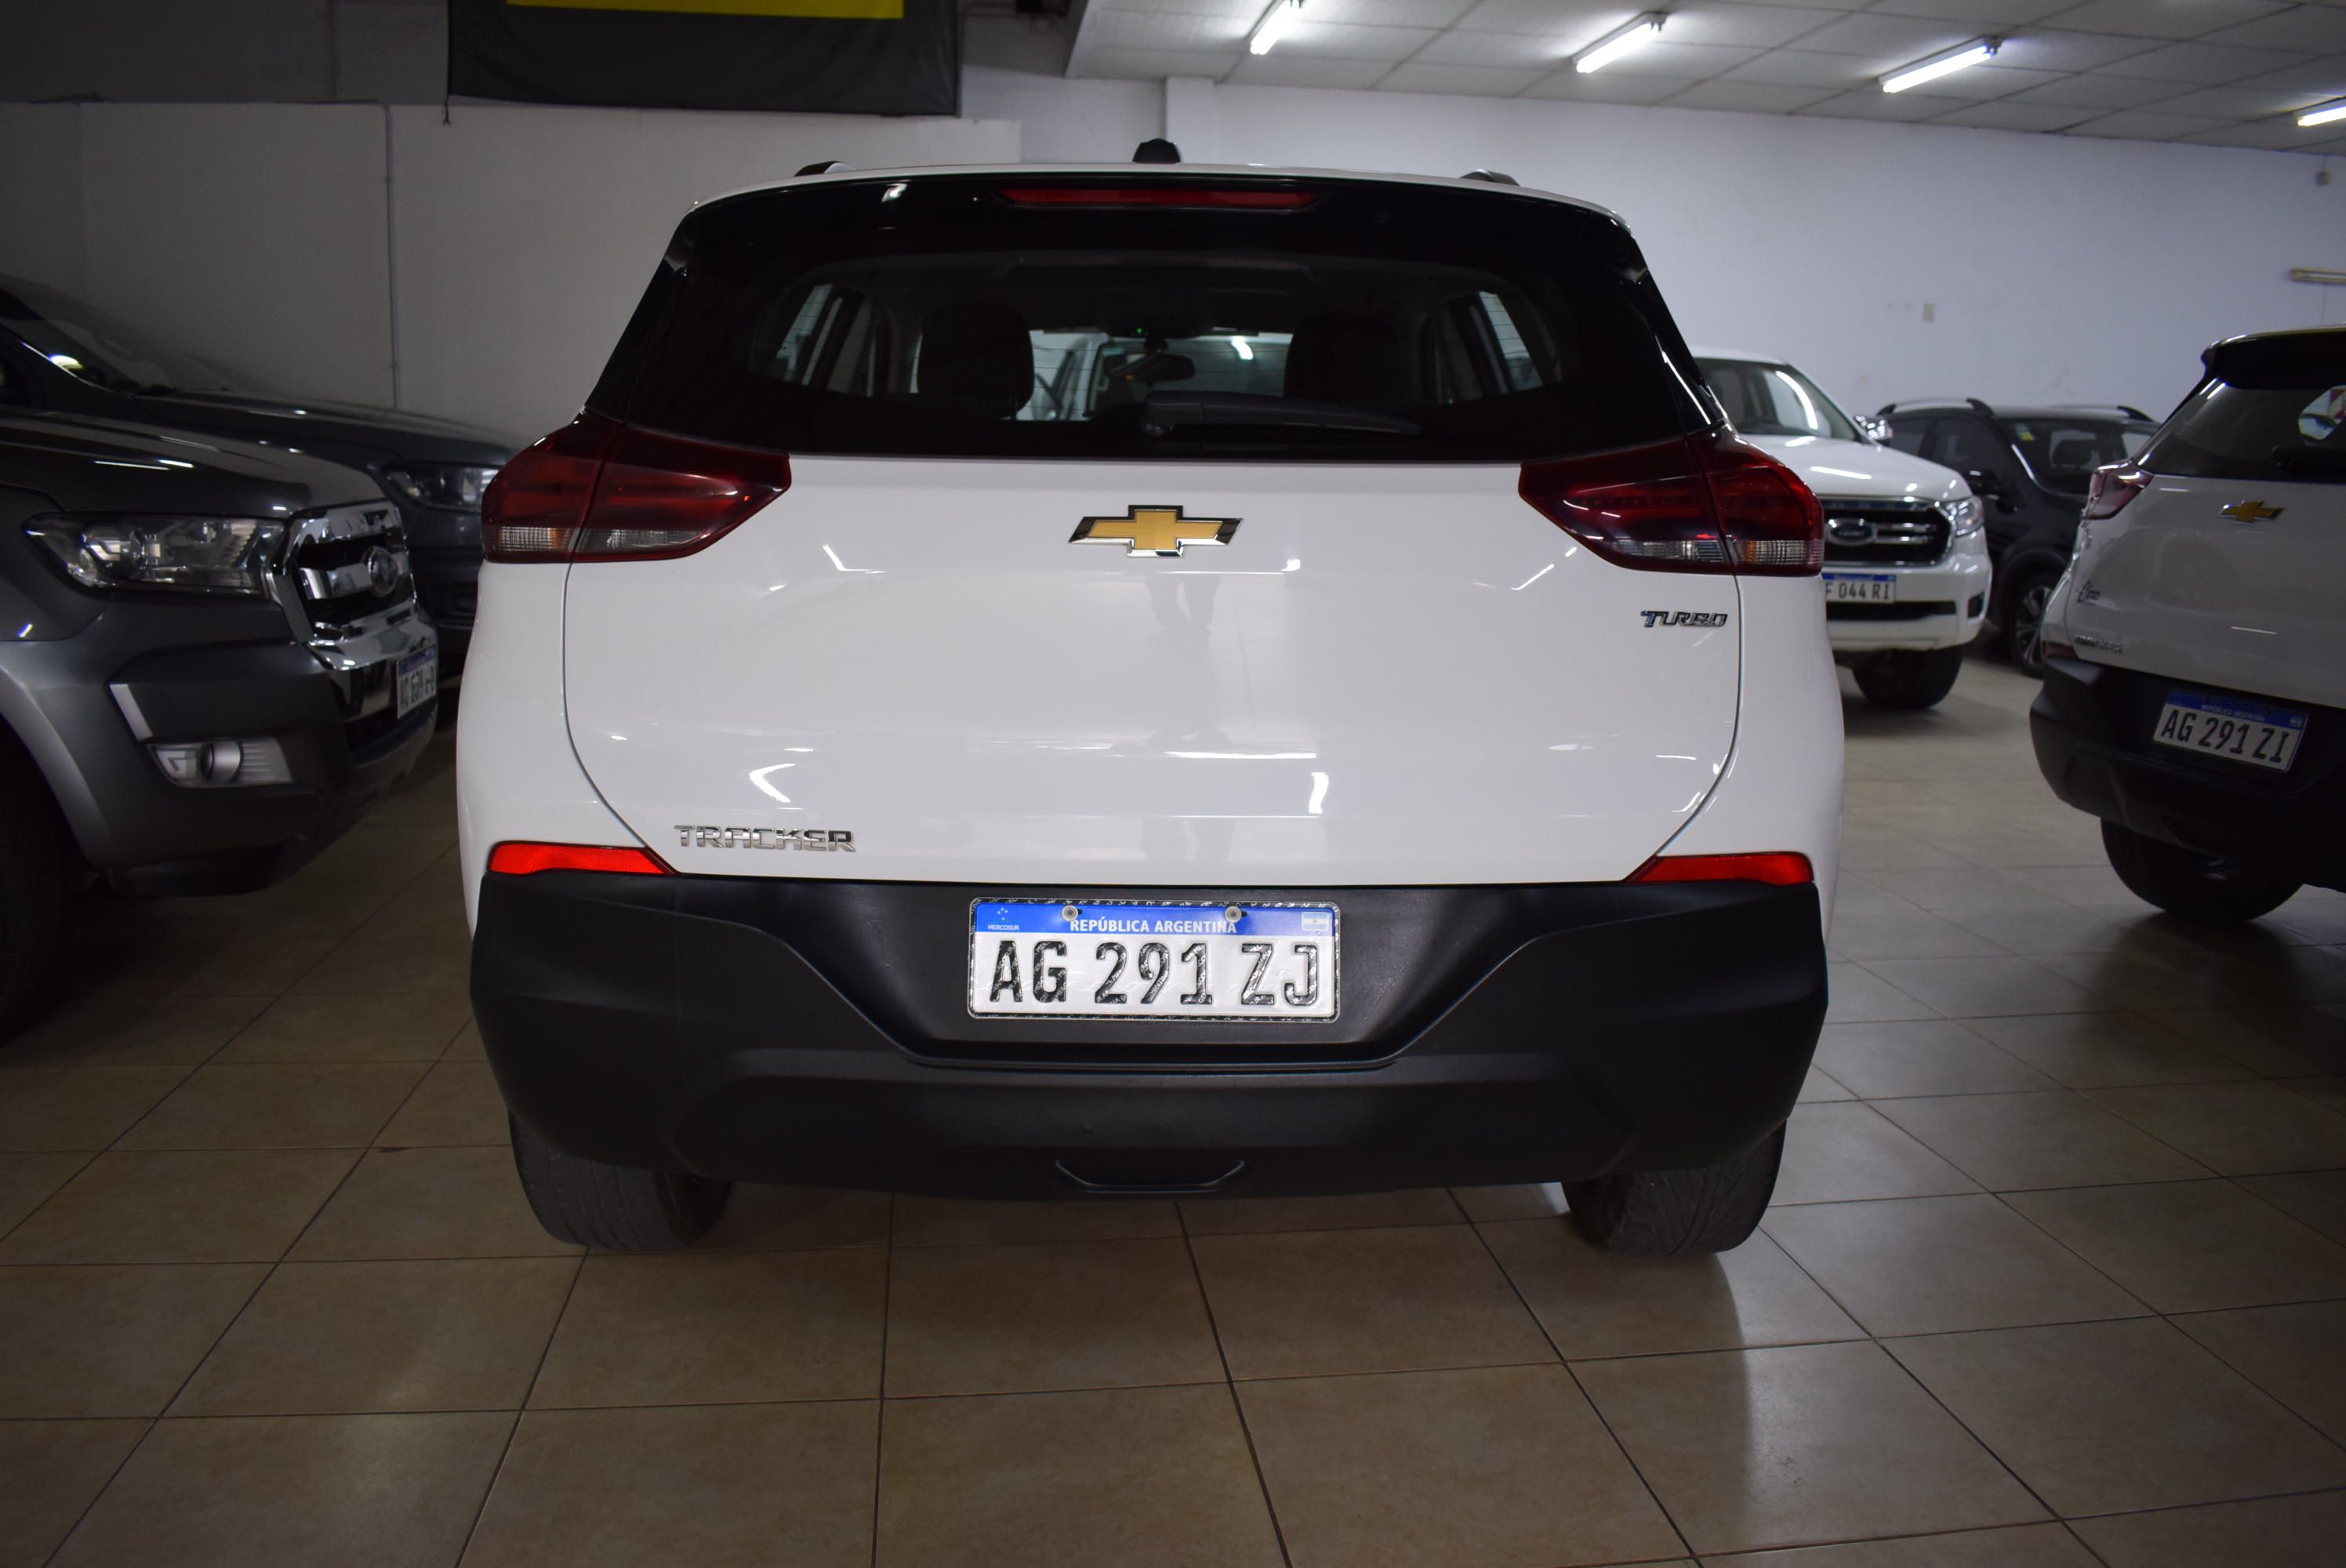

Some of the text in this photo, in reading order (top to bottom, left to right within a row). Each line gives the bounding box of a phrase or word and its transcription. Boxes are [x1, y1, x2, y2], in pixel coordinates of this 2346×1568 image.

[1839, 583, 1866, 599] 044
[1640, 611, 1729, 628] TURBO
[2160, 709, 2290, 763] AG 291 ZI
[674, 825, 857, 853] TRACKER
[1070, 916, 1237, 934] REPÚBLICA ARGENTINA
[990, 940, 1319, 1005] AG 291 ZJ
